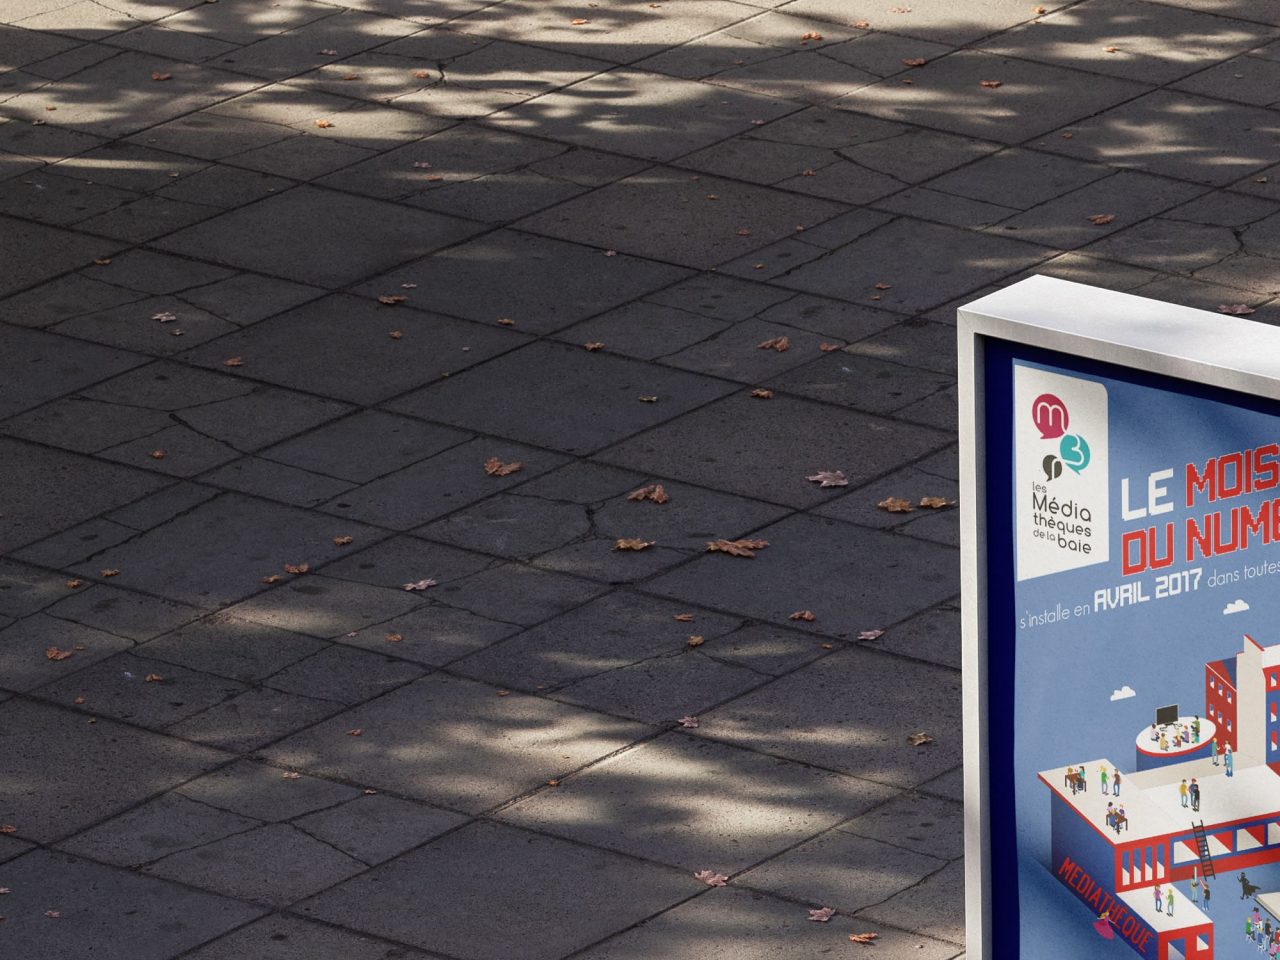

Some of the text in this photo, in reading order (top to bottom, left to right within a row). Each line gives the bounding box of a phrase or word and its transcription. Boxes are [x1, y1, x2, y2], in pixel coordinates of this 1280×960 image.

[1032, 481, 1047, 493] les
[1121, 442, 1280, 521] LE MOIS
[1032, 492, 1092, 522] Média
[1033, 512, 1092, 537] thèques
[1033, 529, 1092, 554] de la baie
[1121, 522, 1175, 577] DU
[1019, 602, 1070, 629] s'installe
[1074, 603, 1090, 617] en
[1094, 581, 1150, 612] AVRIL
[1155, 568, 1203, 599] 2017
[1207, 570, 1246, 588] dans
